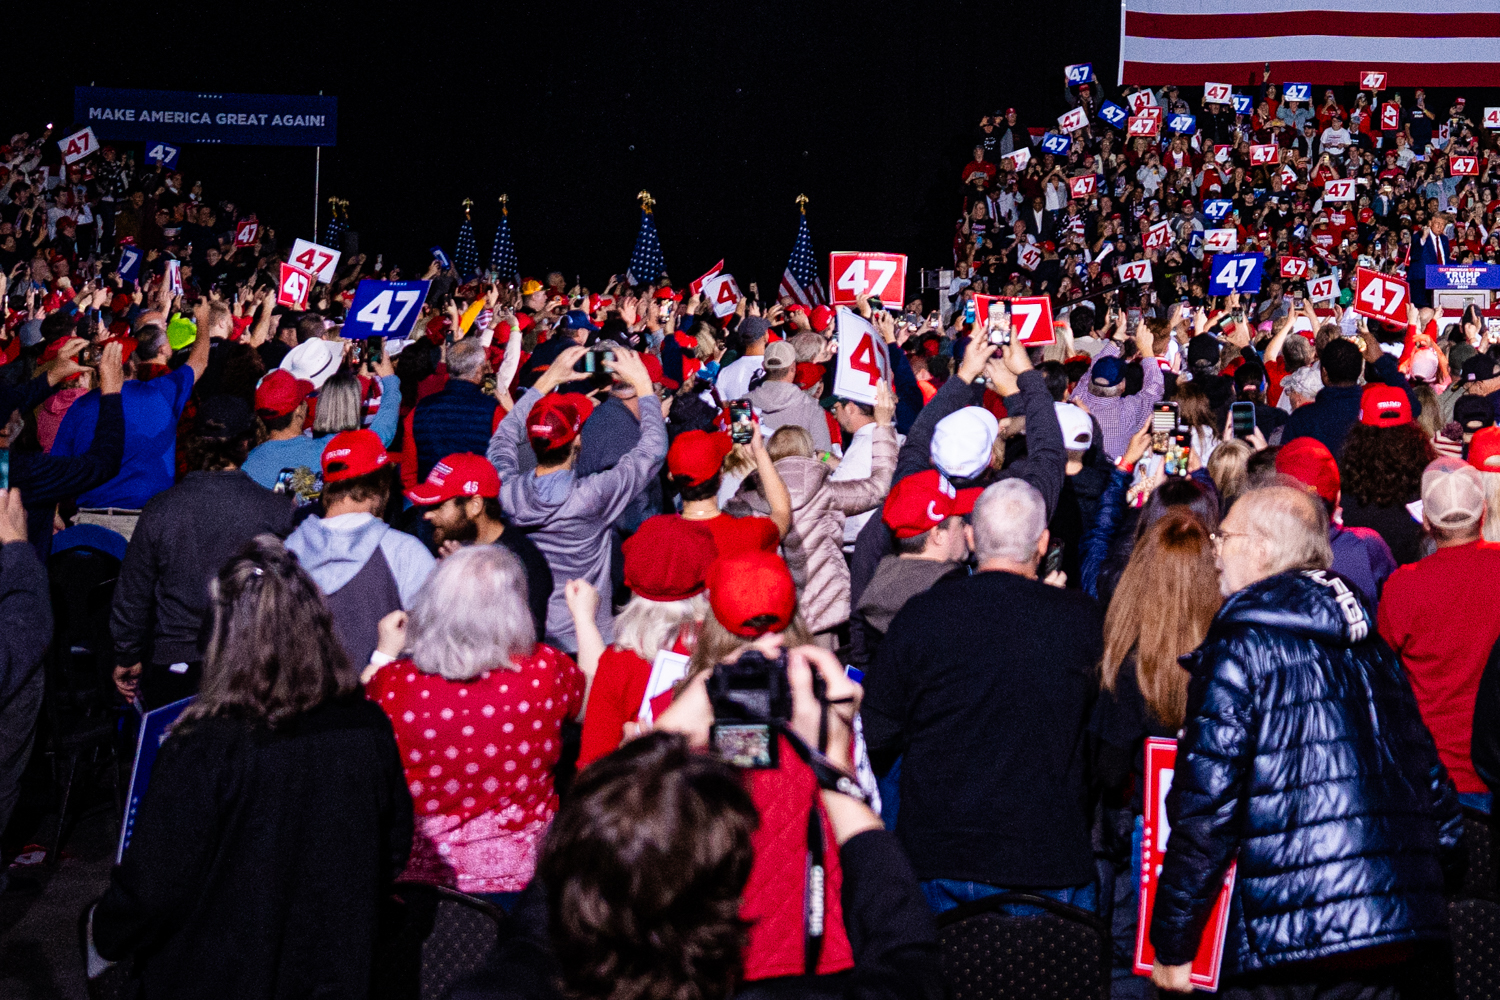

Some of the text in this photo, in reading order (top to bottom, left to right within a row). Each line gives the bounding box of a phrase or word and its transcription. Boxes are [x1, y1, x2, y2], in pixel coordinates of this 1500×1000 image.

[1070, 66, 1090, 82] 47
[1362, 74, 1384, 88] 47
[1207, 86, 1229, 99] 47
[1286, 85, 1308, 98] 47
[89, 107, 325, 127] MAKE AMERICA GREAT AGAIN!
[1062, 111, 1081, 128] 47
[1102, 105, 1126, 123] 47
[1384, 105, 1397, 127] 47
[1130, 119, 1154, 134] 47
[1170, 117, 1193, 131] 47
[66, 132, 90, 157] 47
[1045, 136, 1068, 152] 47
[148, 144, 177, 163] 47
[1254, 147, 1275, 162] 47
[1453, 159, 1475, 172] 47
[1073, 178, 1095, 194] 47
[1328, 183, 1351, 197] 47
[1205, 202, 1229, 216] 47
[238, 223, 258, 243] 47
[1146, 228, 1166, 246] 47
[1208, 232, 1233, 247] 47
[295, 248, 335, 275] 47
[1023, 249, 1040, 266] 47
[1124, 264, 1146, 280] 47
[1216, 258, 1257, 288] 47
[1283, 259, 1307, 275] 47
[1445, 271, 1481, 279] TRUMP
[837, 259, 897, 299] 47
[283, 271, 308, 304] 47
[1312, 279, 1333, 297] 47
[1361, 278, 1406, 315] 47
[356, 289, 421, 332] 47
[1377, 401, 1402, 409] TRUMP
[463, 481, 479, 494] 45
